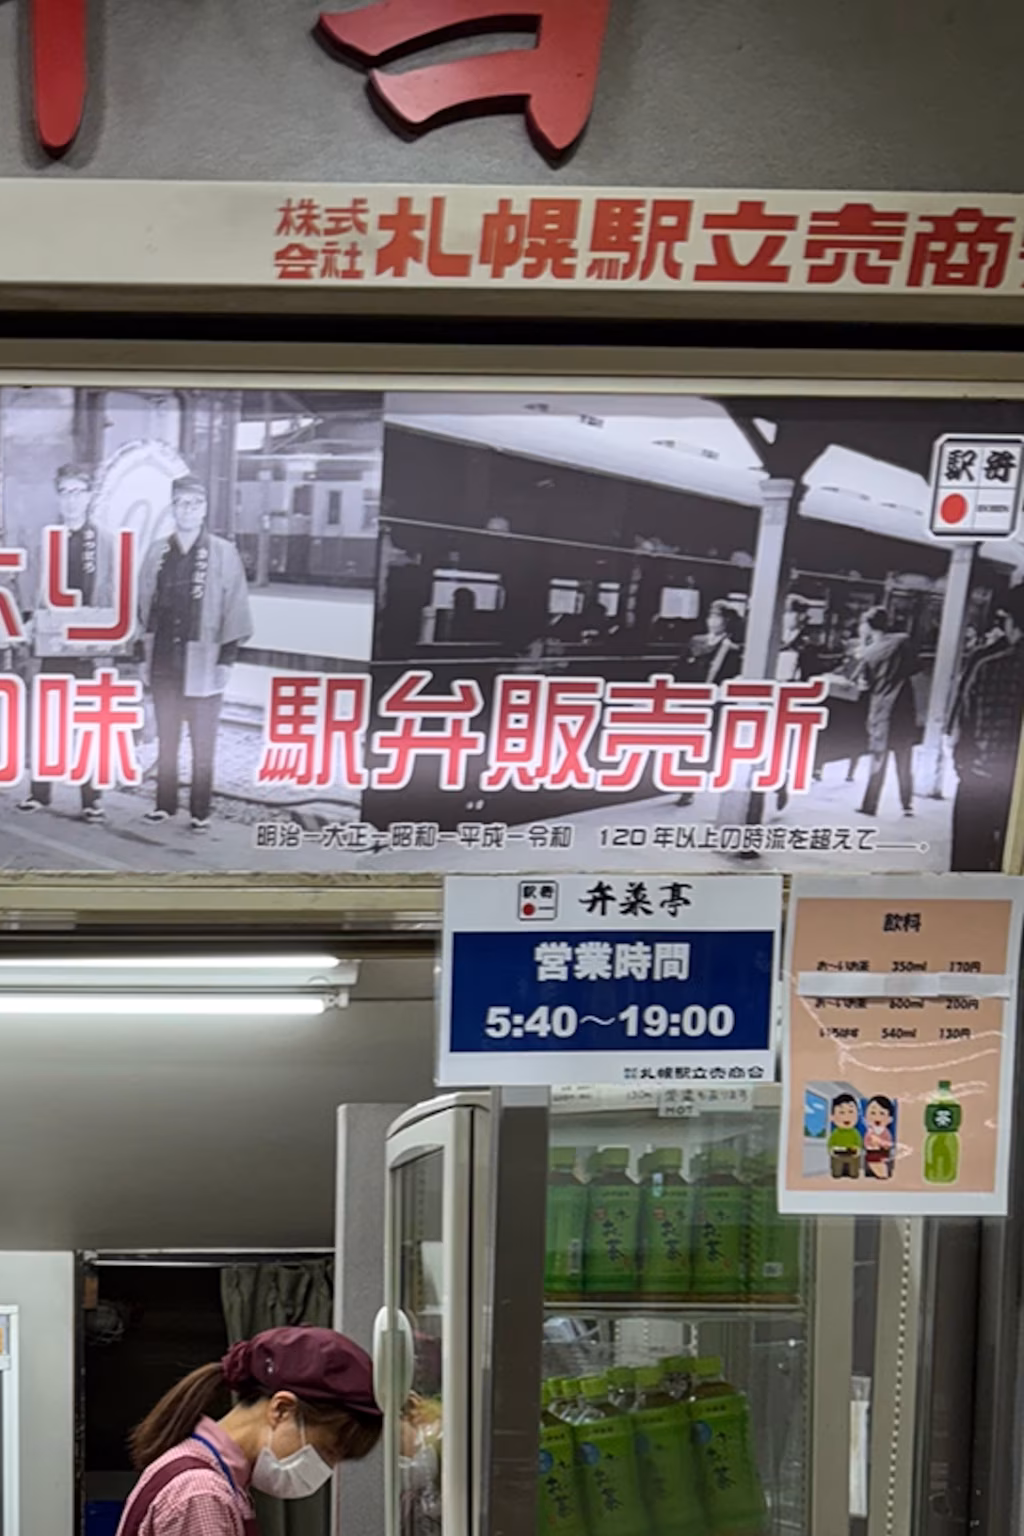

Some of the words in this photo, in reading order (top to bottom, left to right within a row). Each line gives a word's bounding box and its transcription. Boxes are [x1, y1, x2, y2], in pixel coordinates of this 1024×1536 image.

[274, 197, 369, 237] 株式
[273, 242, 365, 280] 会社
[375, 195, 1024, 289] 札幌駅立売商
[258, 672, 828, 791] 駅弁販売所
[578, 881, 694, 917] 弁菜亭
[883, 913, 922, 933] 飲料
[534, 941, 691, 982] 営業時間
[881, 1028, 917, 1039] 540ml
